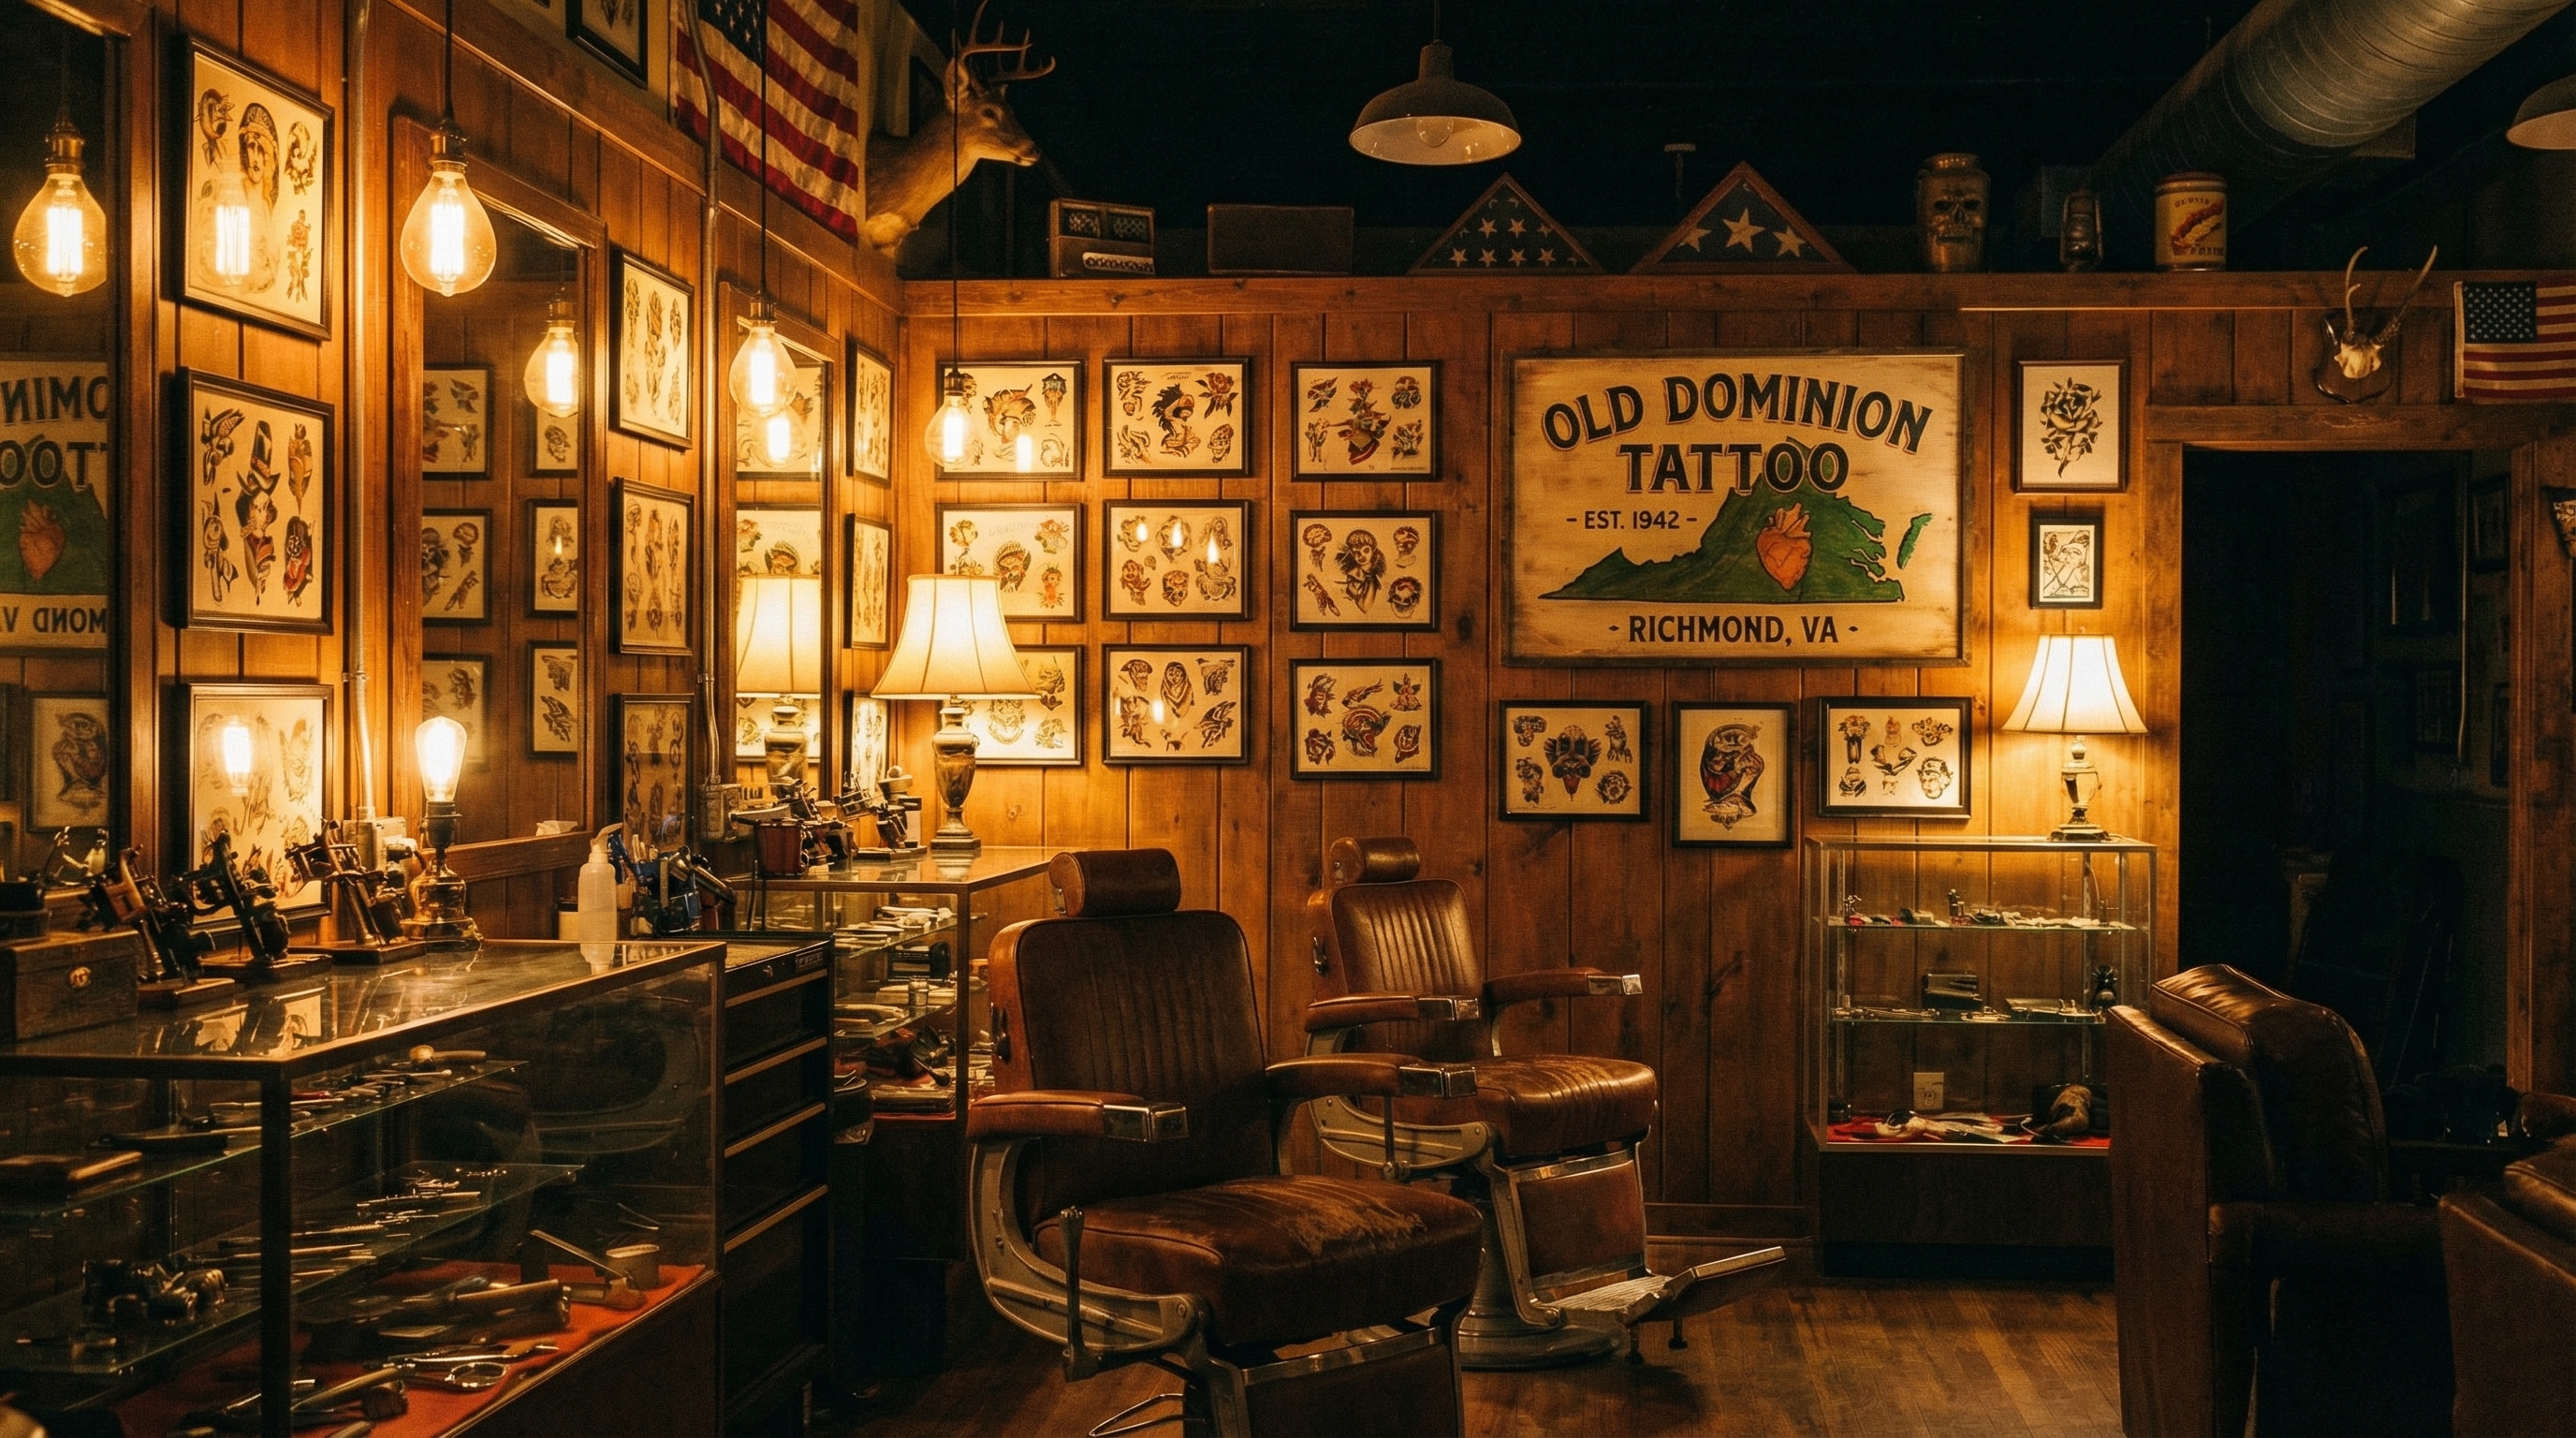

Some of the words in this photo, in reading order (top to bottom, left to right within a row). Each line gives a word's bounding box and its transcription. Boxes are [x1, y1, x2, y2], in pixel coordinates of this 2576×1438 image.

[1542, 384, 1645, 451] OLD
[1662, 373, 1933, 454] DOMINION
[1618, 442, 1850, 495] TATTOO
[1584, 510, 1625, 530] EST.
[1632, 510, 1680, 530] 1942
[1629, 615, 1793, 647] RICHMOND,
[1802, 616, 1838, 643] VA
